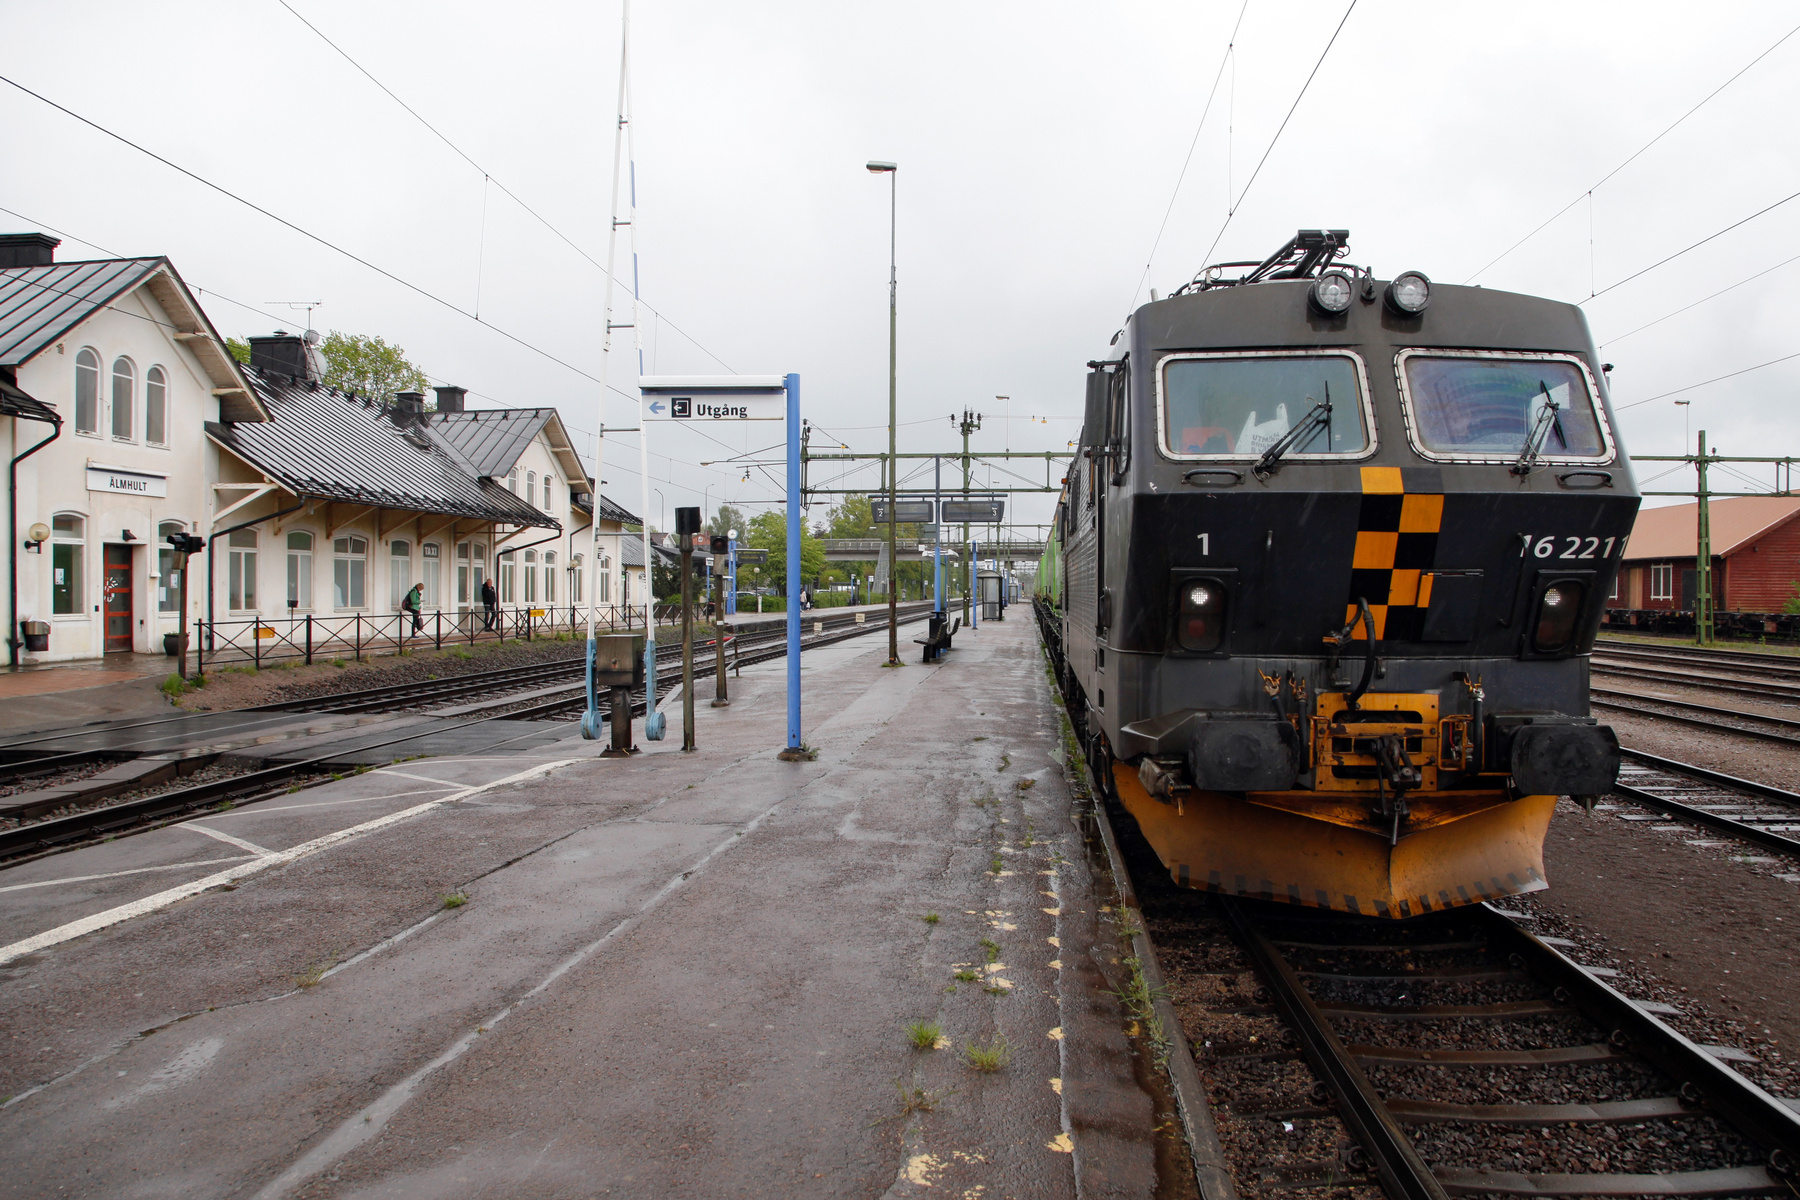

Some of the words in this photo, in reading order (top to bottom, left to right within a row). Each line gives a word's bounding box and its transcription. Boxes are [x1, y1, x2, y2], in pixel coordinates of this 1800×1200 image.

[697, 404, 747, 418] Utgång
[109, 476, 147, 491] ÄLMHULT
[424, 547, 437, 556] TAXI
[1196, 533, 1209, 556] 1
[1520, 535, 1555, 558] 16
[1559, 535, 1629, 559] 2211
